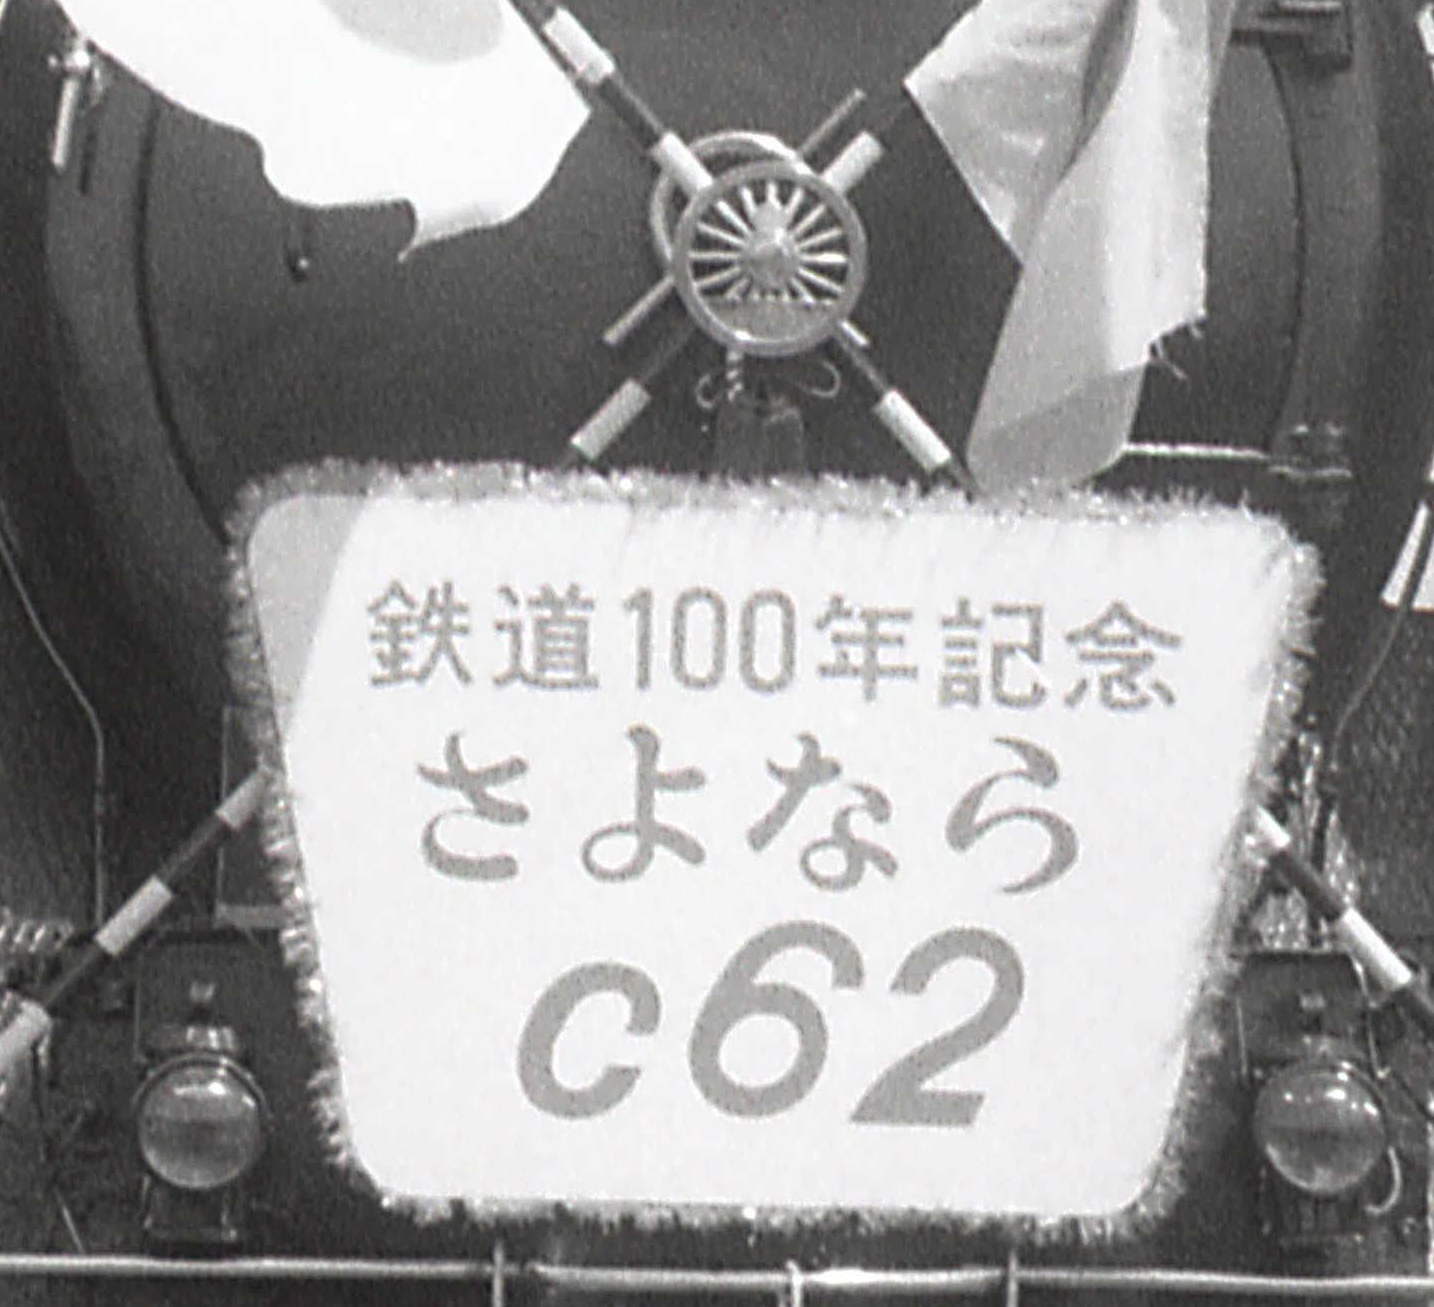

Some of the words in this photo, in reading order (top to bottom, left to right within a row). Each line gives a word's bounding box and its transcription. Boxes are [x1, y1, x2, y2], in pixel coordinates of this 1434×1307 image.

[367, 580, 1182, 712] 鉄道100年記念
[417, 725, 1078, 894] さよなら
